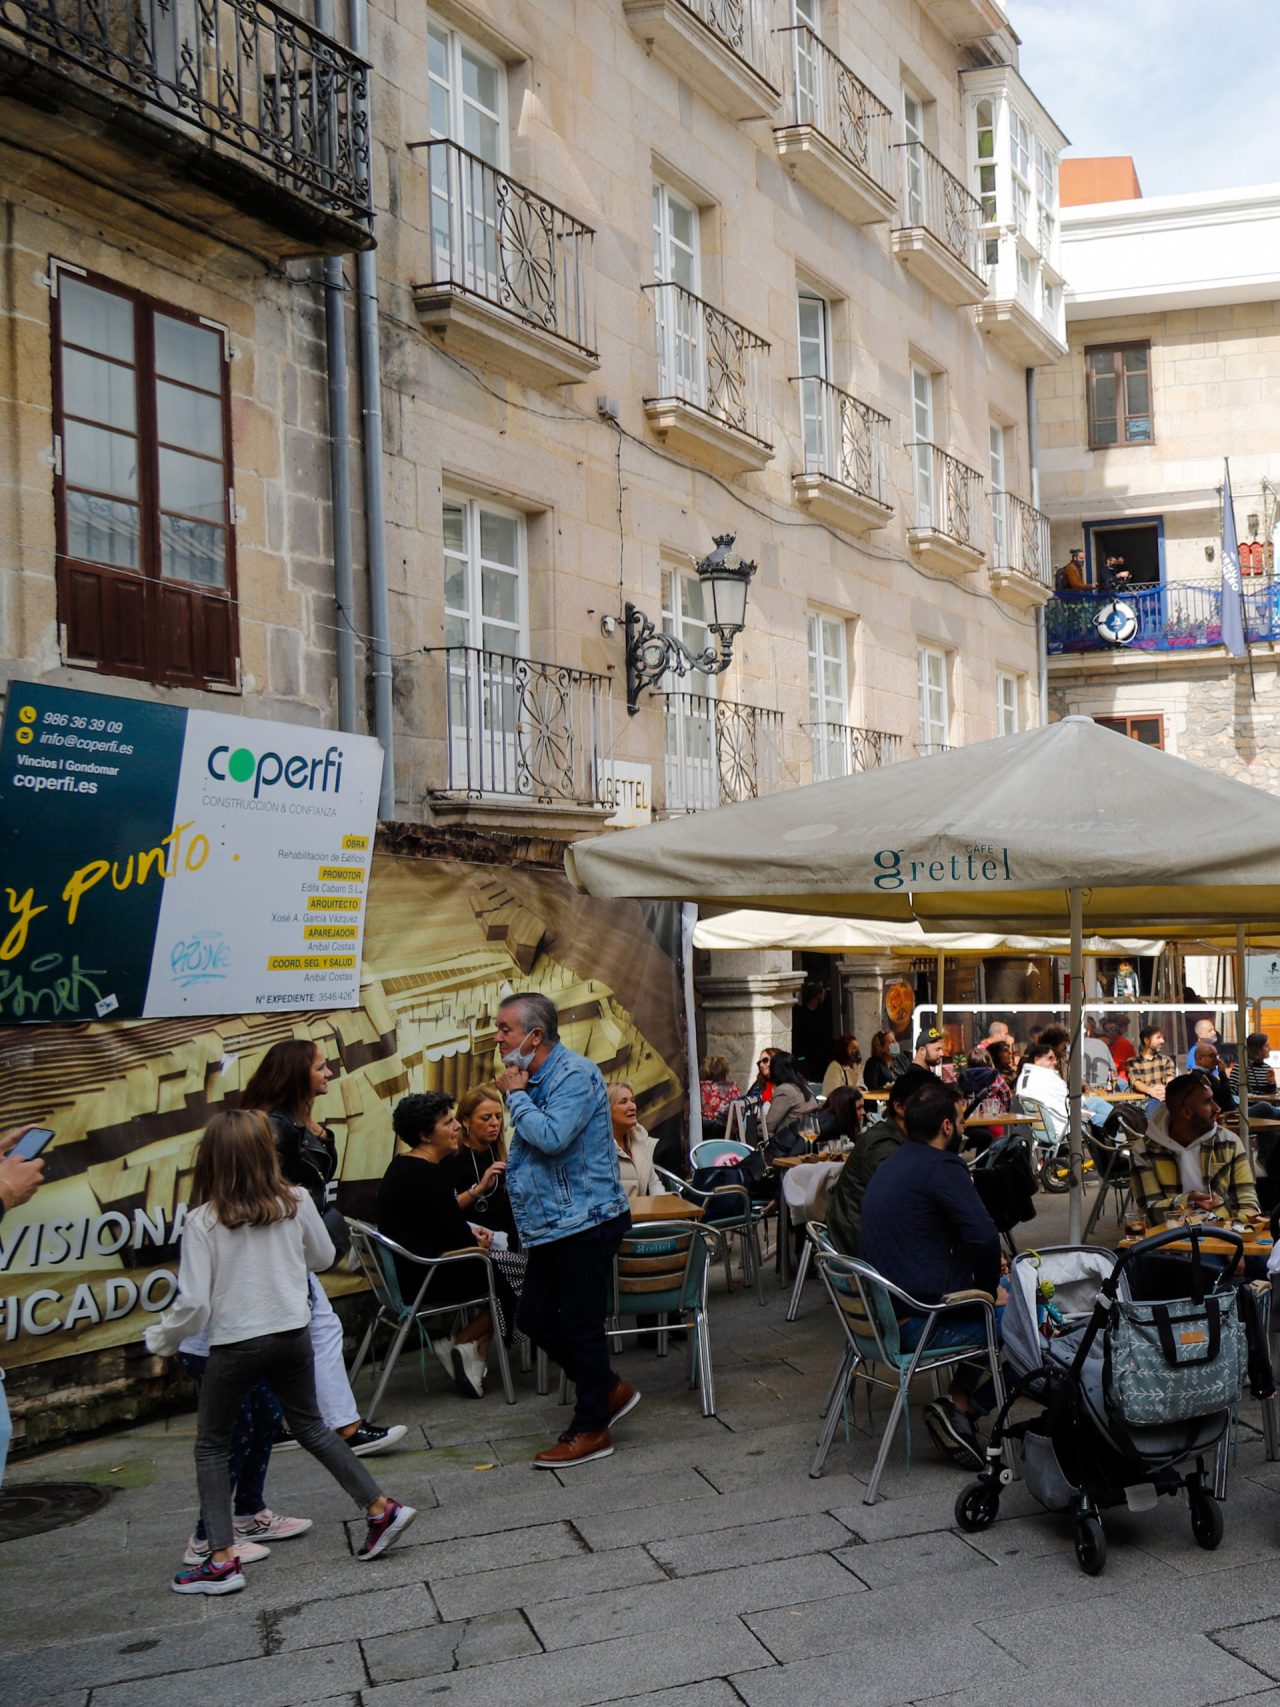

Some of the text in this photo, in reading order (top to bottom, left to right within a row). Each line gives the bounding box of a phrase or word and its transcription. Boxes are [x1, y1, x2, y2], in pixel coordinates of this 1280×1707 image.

[43, 712, 123, 734] 986 36 39 09
[39, 731, 134, 755] info@coperfi.es
[16, 753, 57, 769] Vincios
[65, 760, 120, 776] Gondomar
[207, 745, 343, 799] coperfi
[13, 774, 98, 794] coperfi.es
[280, 802, 287, 813] &
[289, 803, 337, 817] CONFIANZA
[346, 839, 365, 848] OBRA
[330, 852, 339, 862] de
[873, 848, 1013, 890] grettel
[322, 870, 361, 880] PROMOTOR
[310, 899, 358, 909] ARQUITECTO
[308, 928, 355, 938] APAREJADOR
[331, 941, 356, 951] Costas
[304, 958, 320, 968] SEG.
[329, 957, 353, 967] SALUD
[328, 972, 353, 982] Costas
